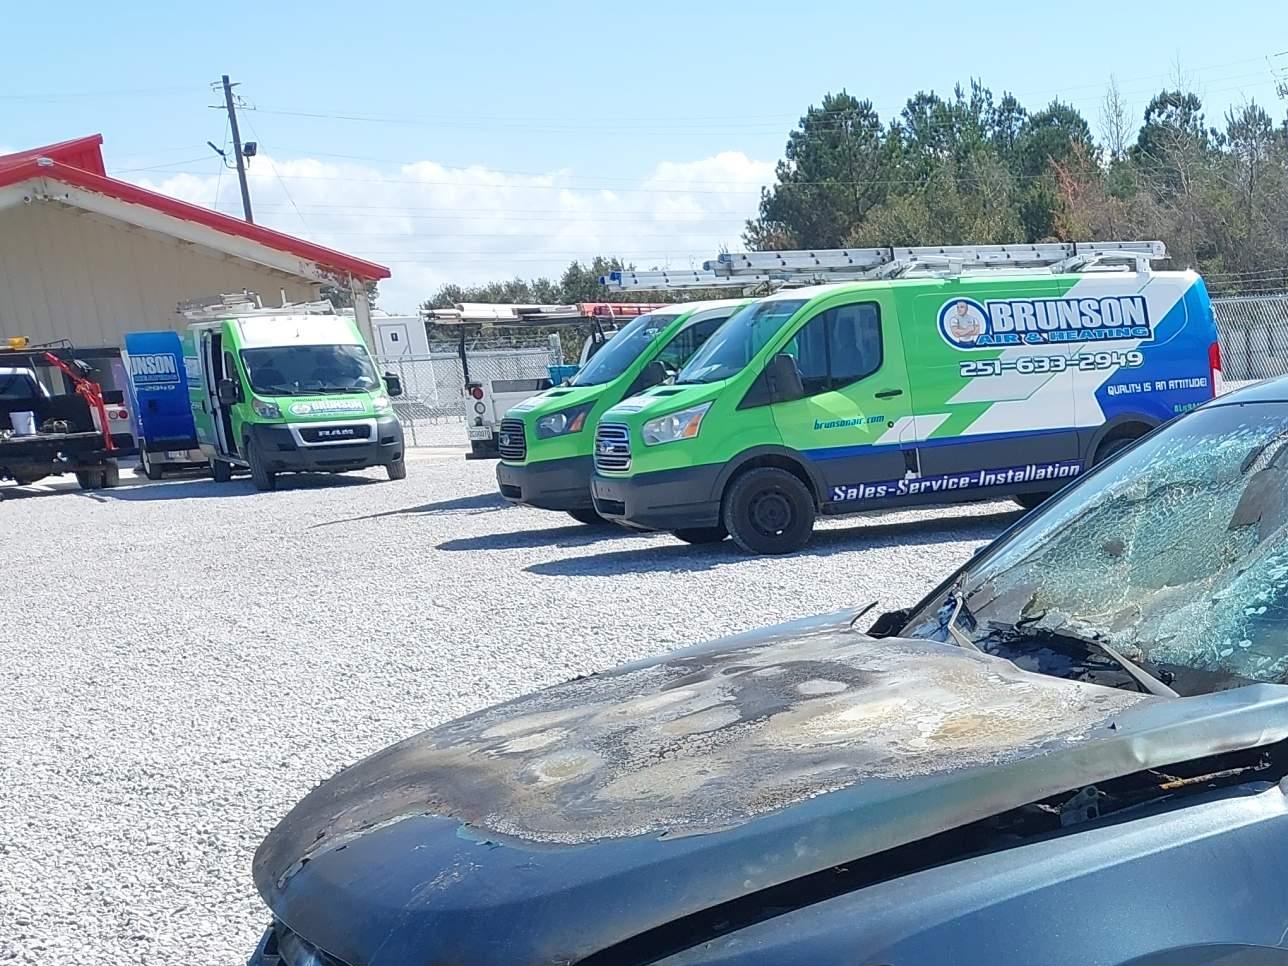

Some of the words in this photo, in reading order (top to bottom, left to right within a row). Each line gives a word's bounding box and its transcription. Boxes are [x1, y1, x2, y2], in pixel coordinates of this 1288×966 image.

[989, 297, 1147, 333] BRUNSON
[976, 333, 1020, 346] AIR
[1024, 332, 1044, 343] &
[1050, 327, 1149, 342] HEATING
[959, 351, 1145, 377] 251-633-2949
[1107, 383, 1141, 396] QUALITY
[1143, 382, 1152, 392] IS
[1155, 381, 1167, 391] AN
[814, 415, 885, 430] brunsonair.com
[833, 463, 1080, 501] Sales-Service-Installation
